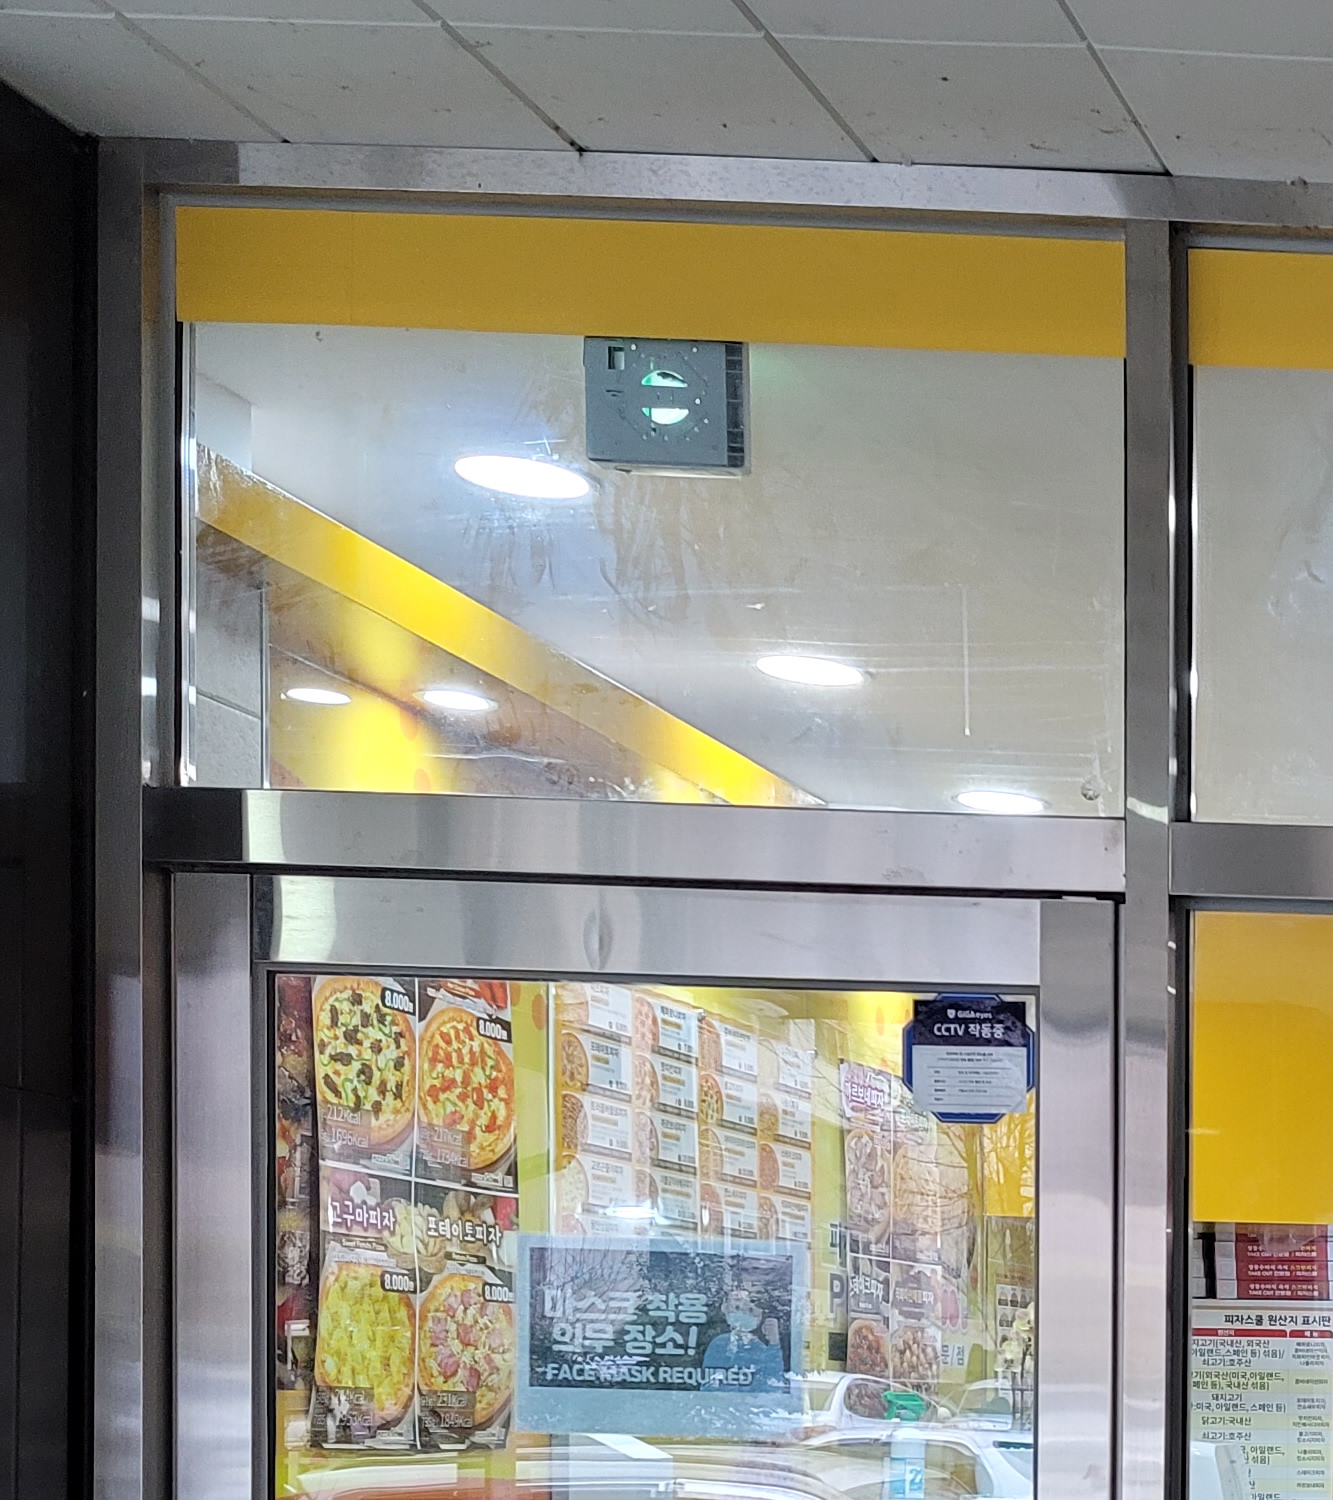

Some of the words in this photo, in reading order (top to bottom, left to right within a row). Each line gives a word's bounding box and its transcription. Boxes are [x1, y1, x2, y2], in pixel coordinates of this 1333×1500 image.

[933, 1023, 966, 1037] CCTV
[968, 1023, 1005, 1038] 작동중
[331, 1202, 395, 1231] 고구마피자
[427, 1216, 502, 1246] 포테이토피자
[543, 1284, 643, 1320] 마스크
[649, 1292, 708, 1324] 착용
[1224, 1314, 1264, 1326] 피자스쿨
[1267, 1314, 1298, 1326] 원산지
[1301, 1316, 1331, 1326] 표시판
[552, 1323, 616, 1353] 의무
[623, 1325, 698, 1356] 장소!
[1246, 1339, 1270, 1348] 외국산
[1250, 1349, 1261, 1358] 등)
[1202, 1358, 1252, 1367] 쇠고기:호주산
[546, 1364, 597, 1382] FACE
[600, 1366, 657, 1382] MASK
[659, 1366, 754, 1386] REQUIRED
[1225, 1381, 1249, 1390] 국내산
[1251, 1381, 1270, 1391] 섞음)
[1212, 1393, 1242, 1402] 돼지고기
[1216, 1404, 1249, 1412] 아일랜드,
[1250, 1404, 1274, 1413] 스페인
[1275, 1404, 1286, 1413] 등)
[1201, 1416, 1252, 1425] 닭고기:국내산
[1202, 1432, 1252, 1441] 쇠고기:호주산
[1250, 1446, 1285, 1455] 아일랜드,
[1251, 1456, 1270, 1465] 섞음)
